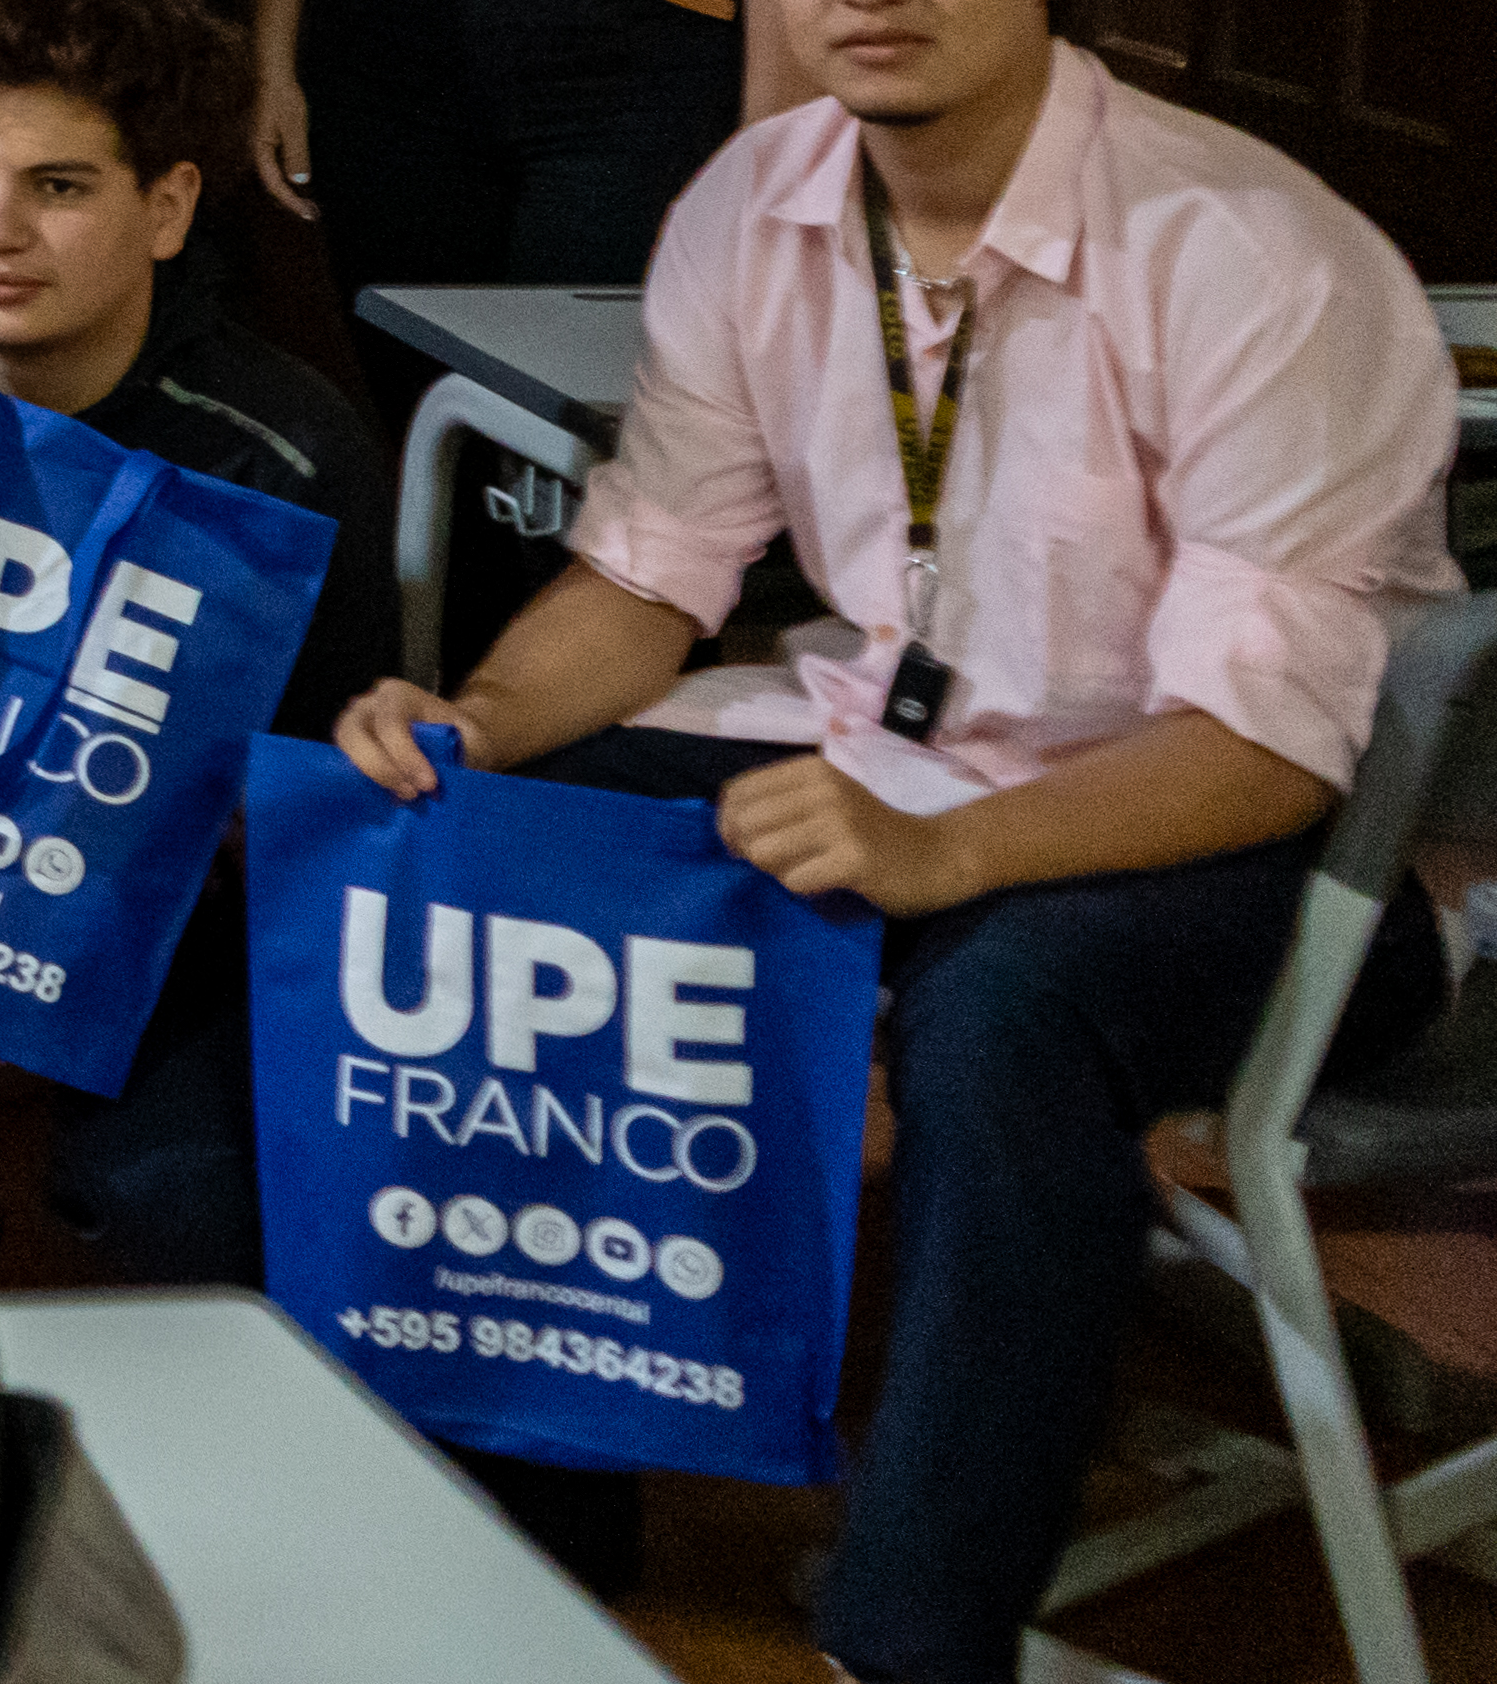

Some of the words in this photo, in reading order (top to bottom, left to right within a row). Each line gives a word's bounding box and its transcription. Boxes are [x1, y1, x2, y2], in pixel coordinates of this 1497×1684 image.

[341, 885, 755, 1106] UPE
[335, 1054, 757, 1193] FRANCO
[336, 1303, 461, 1353] +595
[471, 1316, 745, 1410] 984364238
